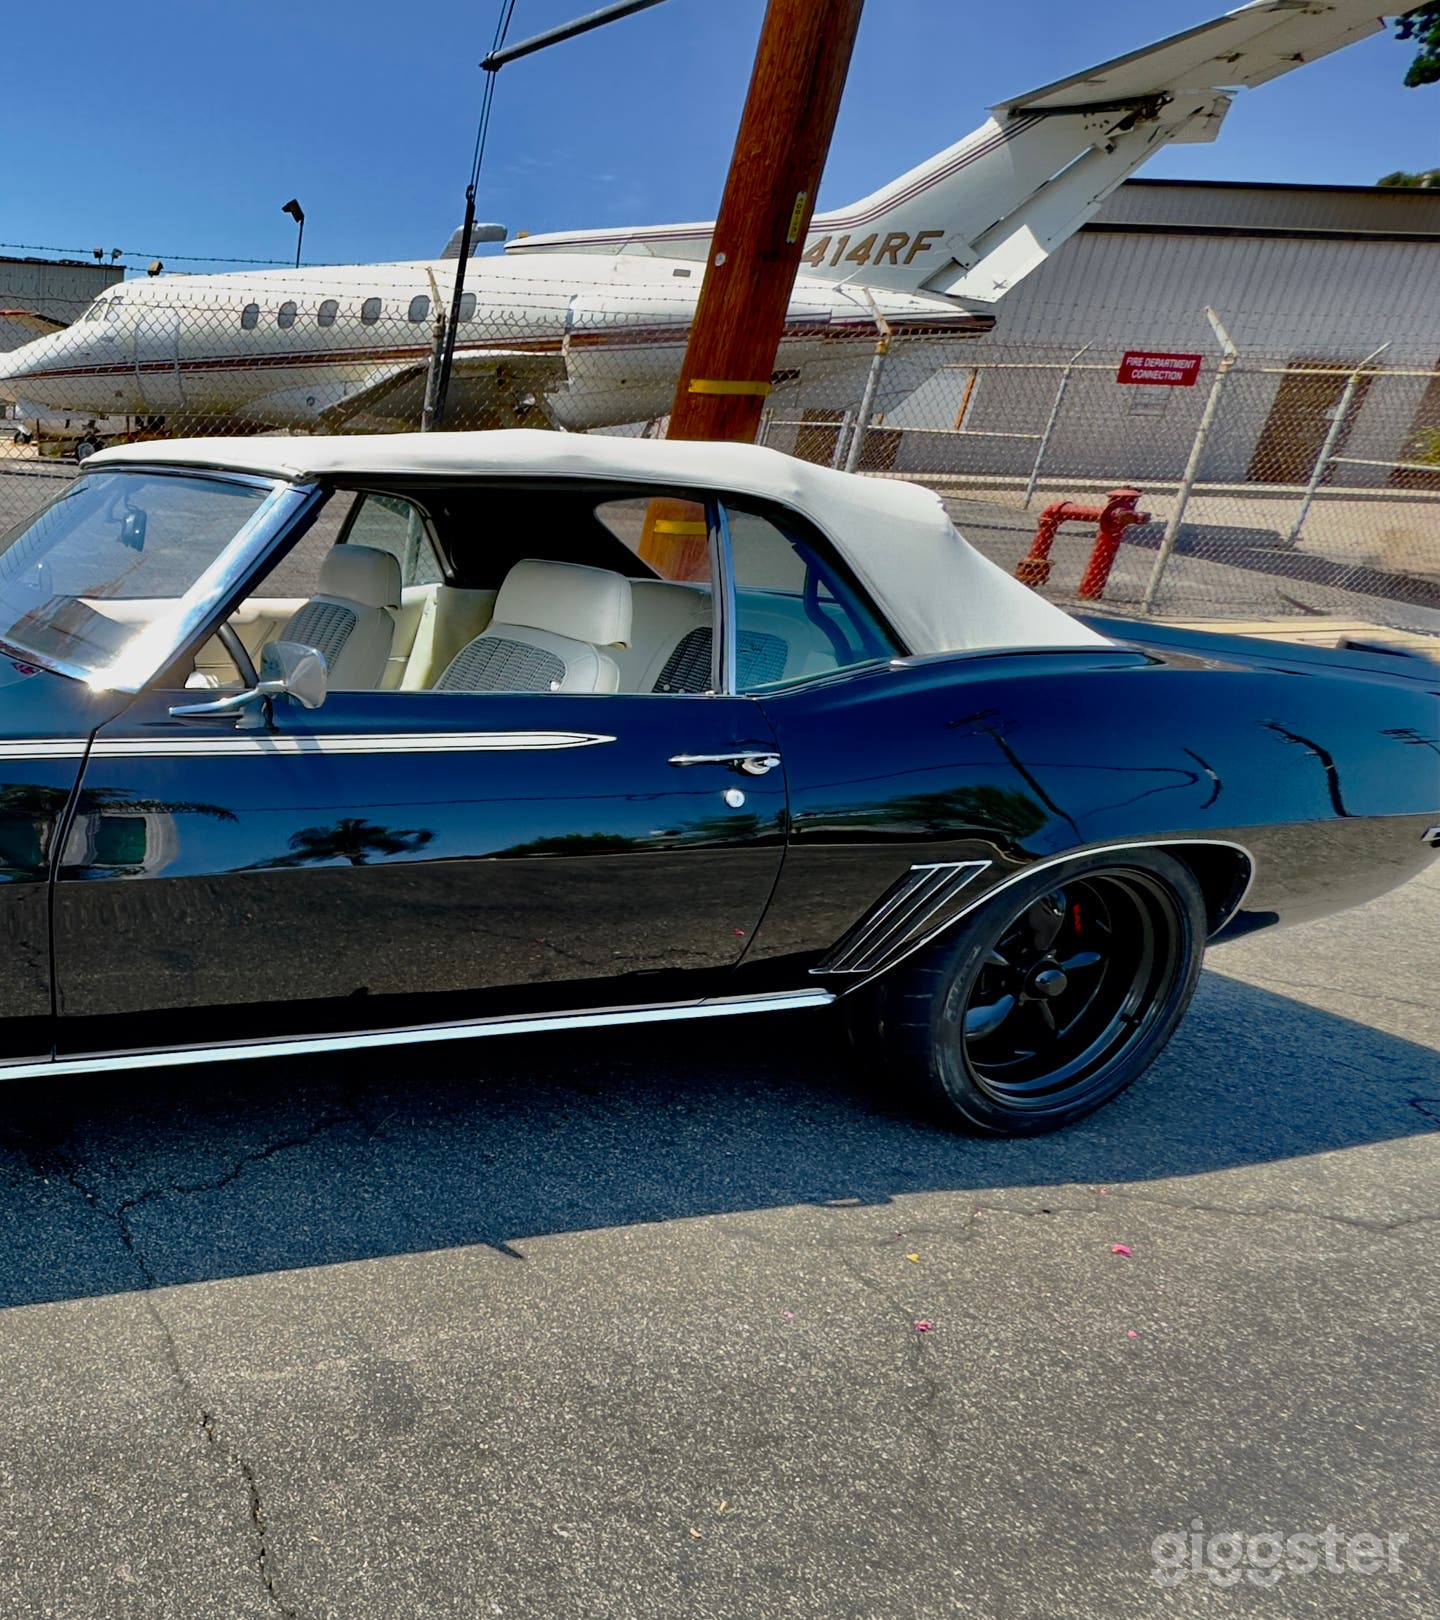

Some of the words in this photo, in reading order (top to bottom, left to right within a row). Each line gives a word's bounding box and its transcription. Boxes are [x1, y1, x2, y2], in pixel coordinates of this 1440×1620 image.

[802, 231, 945, 267] 414RF
[1126, 357, 1143, 366] FIRE
[1144, 358, 1196, 368] DEPARTMENT
[1131, 369, 1183, 380] CONNECTION
